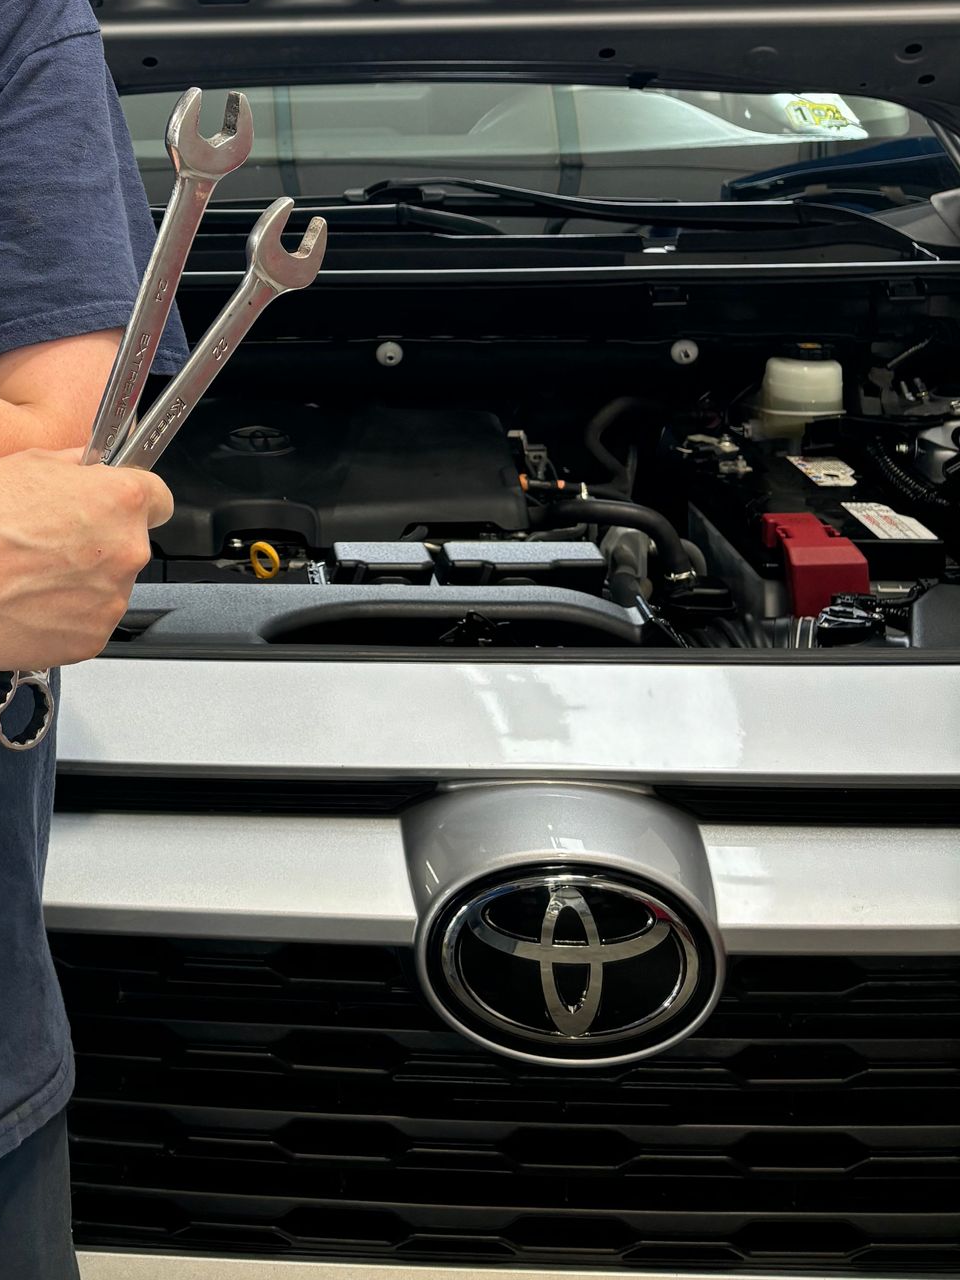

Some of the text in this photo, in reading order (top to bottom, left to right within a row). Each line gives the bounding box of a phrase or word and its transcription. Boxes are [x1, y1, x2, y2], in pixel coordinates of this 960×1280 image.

[154, 278, 169, 304] 24
[212, 336, 229, 361] 22
[114, 333, 150, 418] EXTREME
